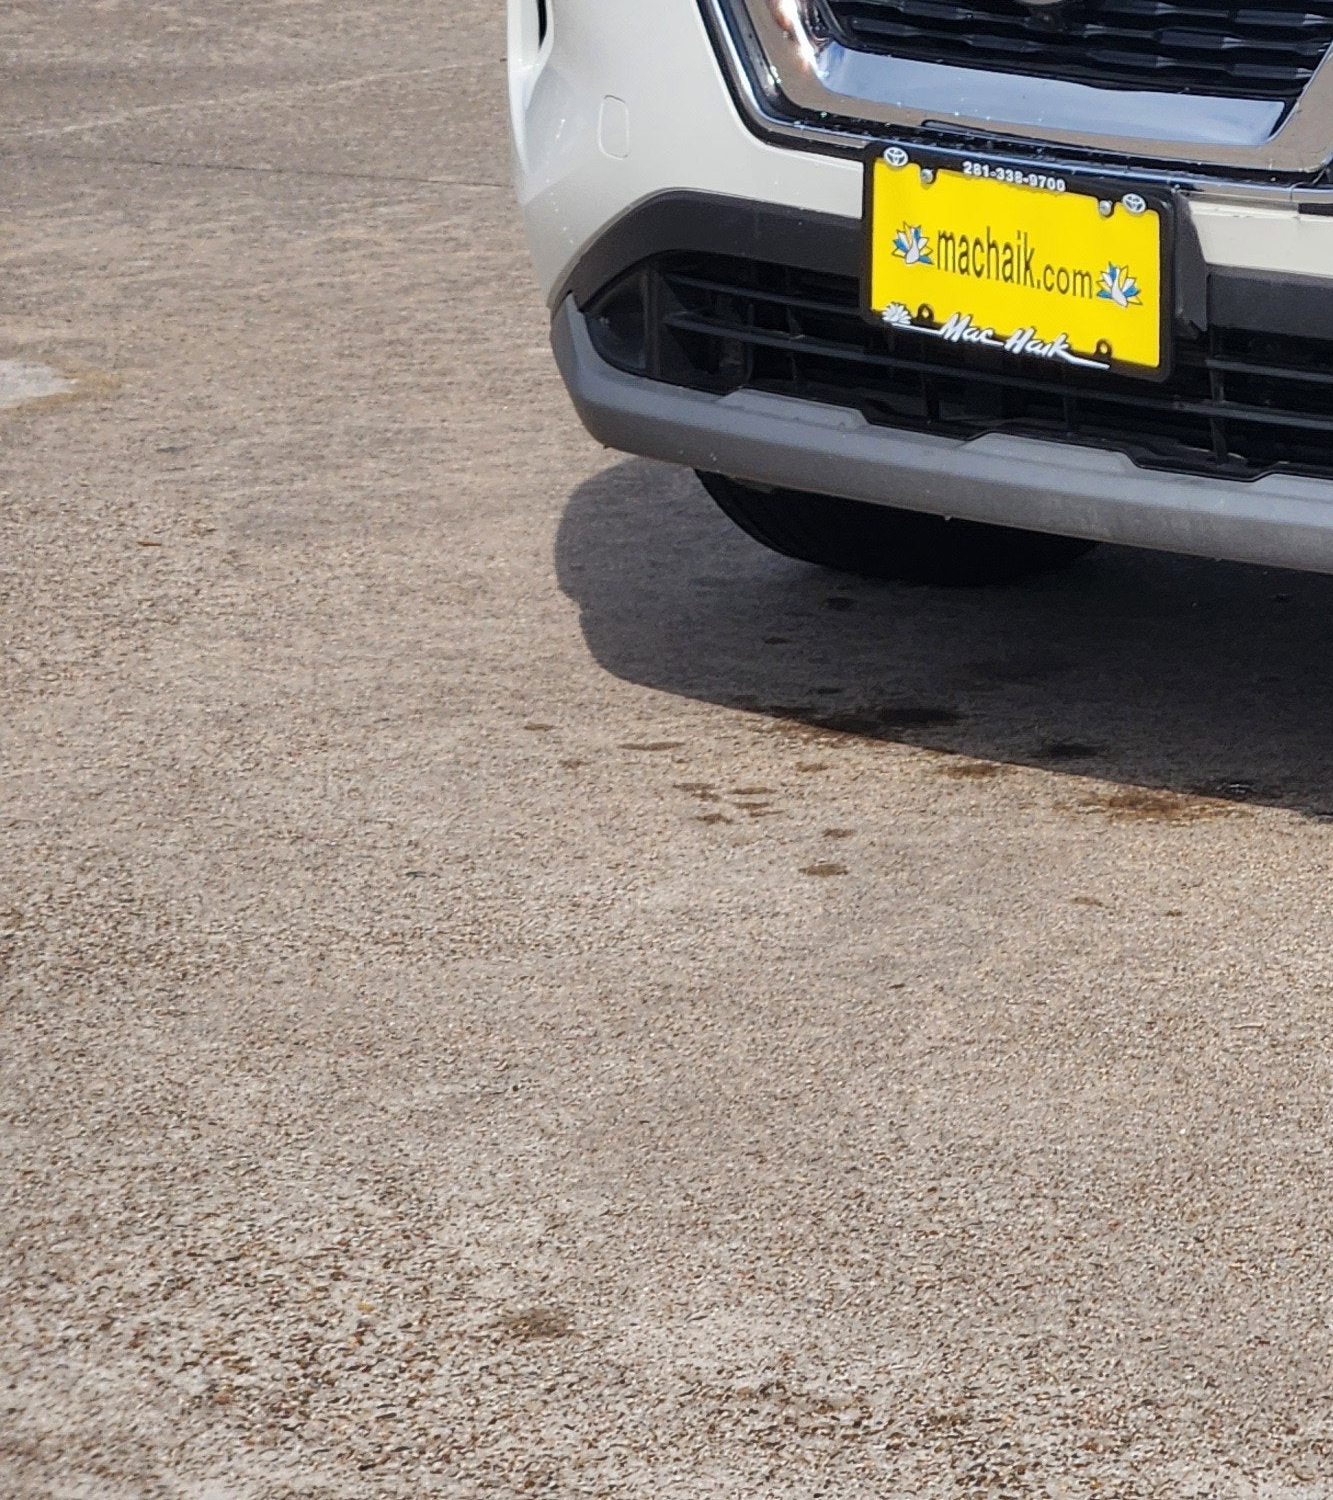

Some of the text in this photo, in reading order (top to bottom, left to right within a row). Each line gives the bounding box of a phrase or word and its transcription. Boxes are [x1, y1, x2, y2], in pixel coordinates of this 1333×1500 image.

[962, 160, 1067, 192] 281-338-9700
[936, 226, 1094, 300] machaik.com
[938, 311, 1077, 361] Mac Haik
